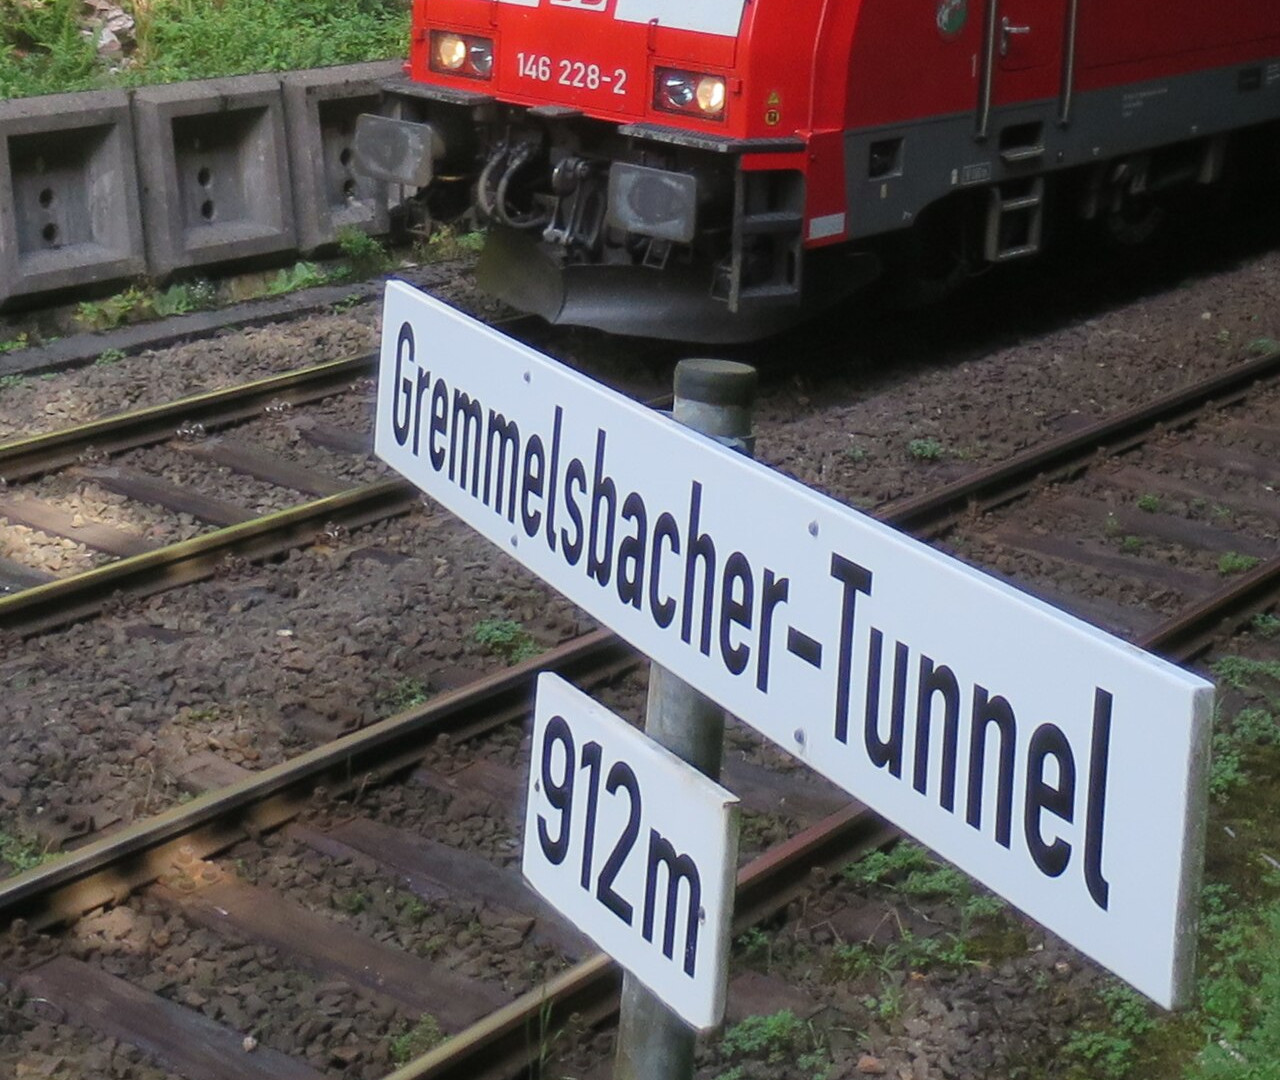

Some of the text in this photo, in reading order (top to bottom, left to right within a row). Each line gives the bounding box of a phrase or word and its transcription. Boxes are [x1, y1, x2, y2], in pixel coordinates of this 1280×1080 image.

[516, 52, 628, 96] 146 228-2
[391, 319, 1114, 913] Gremmelsbacher-Tunnel
[536, 714, 703, 979] 912m
